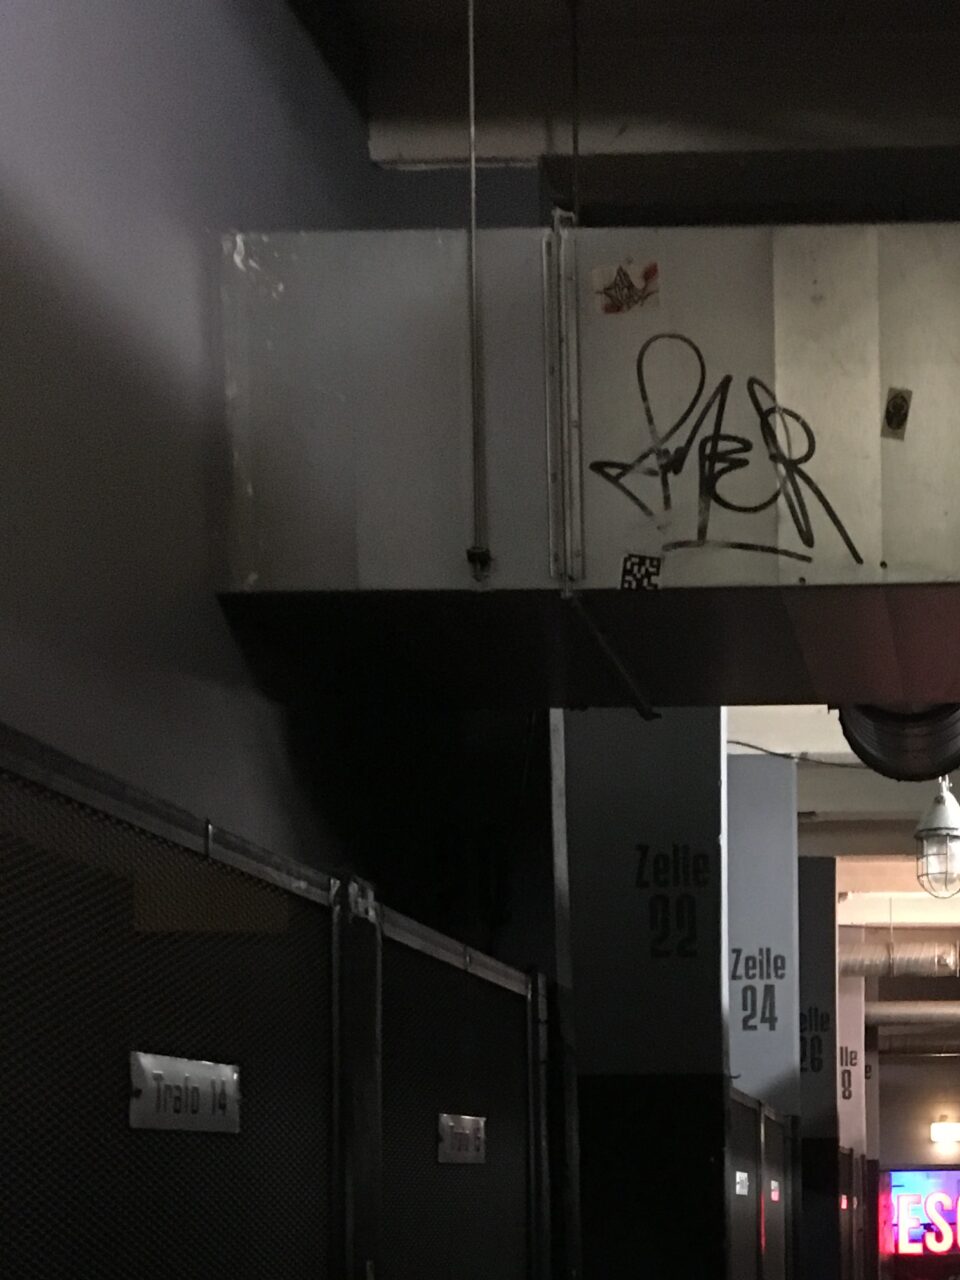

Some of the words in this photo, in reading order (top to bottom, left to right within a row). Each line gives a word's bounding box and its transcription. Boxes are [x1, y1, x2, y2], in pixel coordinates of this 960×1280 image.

[635, 843, 711, 889] Zeile
[651, 893, 697, 958] 22
[731, 947, 787, 981] Zeile
[741, 984, 778, 1031] 24
